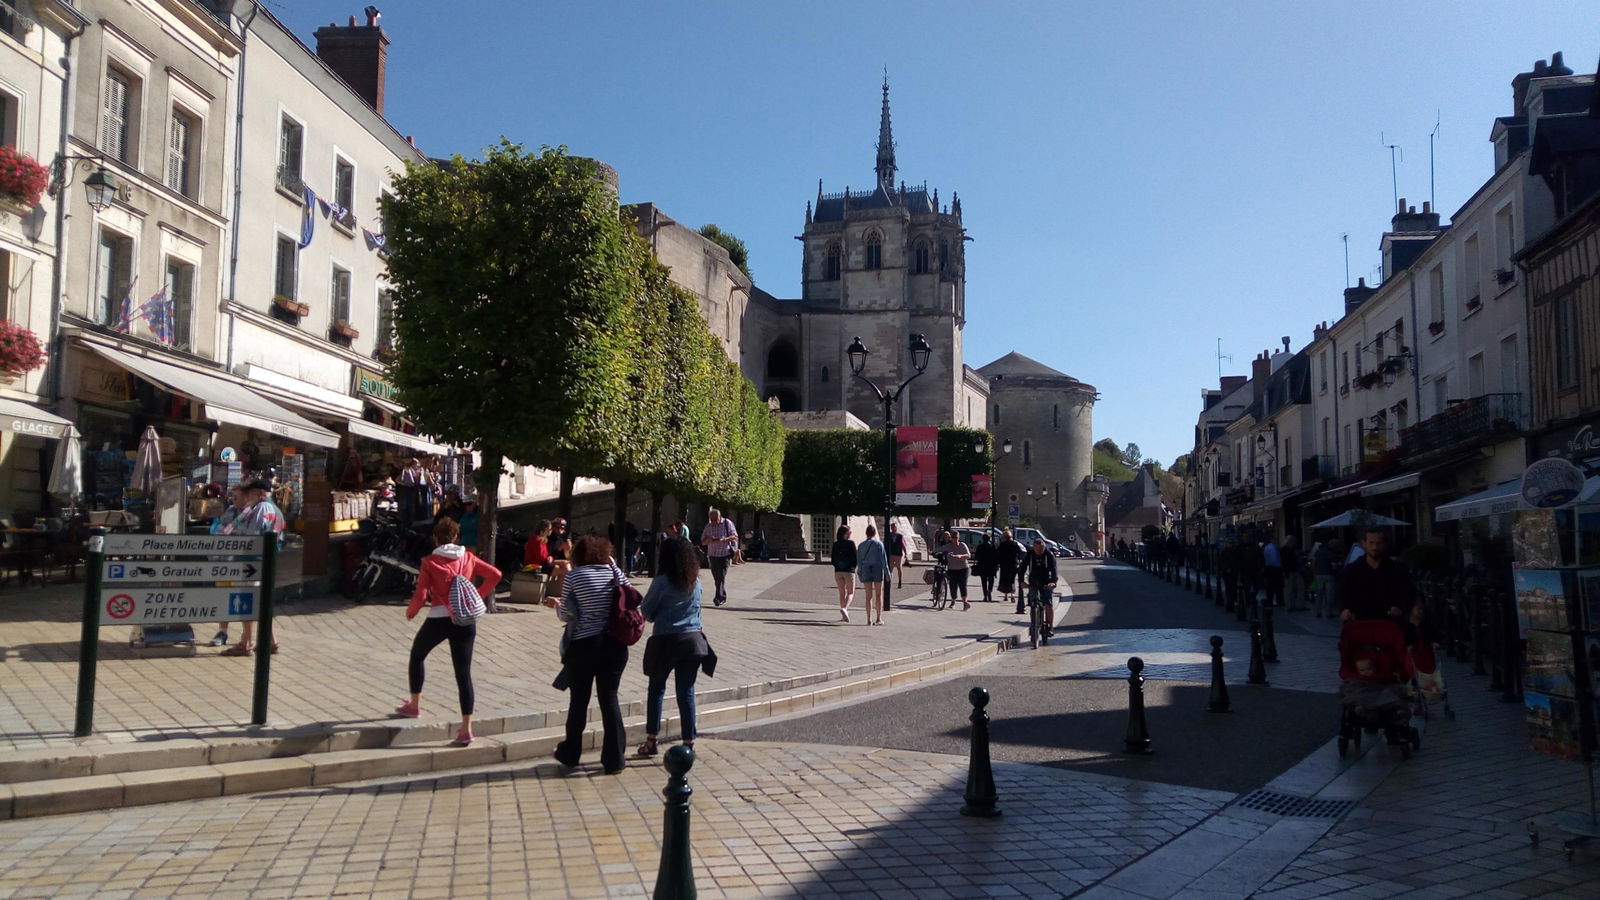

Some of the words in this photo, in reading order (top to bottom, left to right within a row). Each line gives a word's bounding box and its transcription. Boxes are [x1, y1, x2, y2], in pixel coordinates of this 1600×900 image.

[12, 420, 55, 436] GLACES
[142, 539, 174, 551] Place
[176, 540, 215, 551] Michel
[162, 566, 202, 577] Gratuit
[211, 566, 228, 577] 50
[229, 568, 240, 577] m
[145, 592, 185, 604] ZONE
[143, 606, 218, 619] PIÉTONNE
